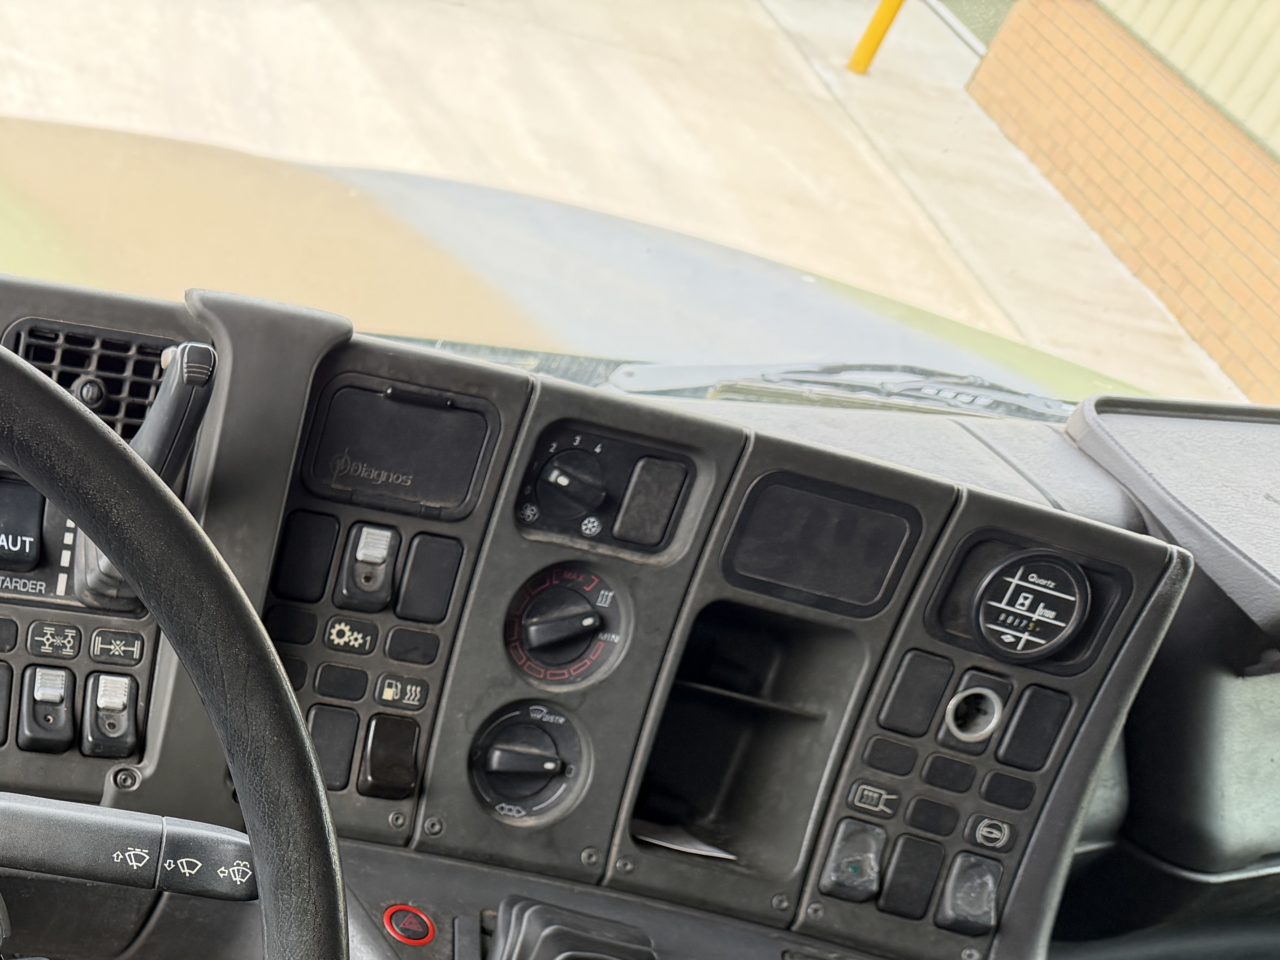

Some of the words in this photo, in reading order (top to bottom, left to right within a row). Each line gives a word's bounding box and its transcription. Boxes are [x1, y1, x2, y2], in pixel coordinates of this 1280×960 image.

[573, 436, 581, 446] 3
[548, 442, 557, 453] 2
[594, 443, 602, 453] 4
[351, 462, 414, 486] Diagnos
[1027, 573, 1056, 588] Quartz
[365, 636, 371, 650] 1
[599, 633, 619, 643] MIN
